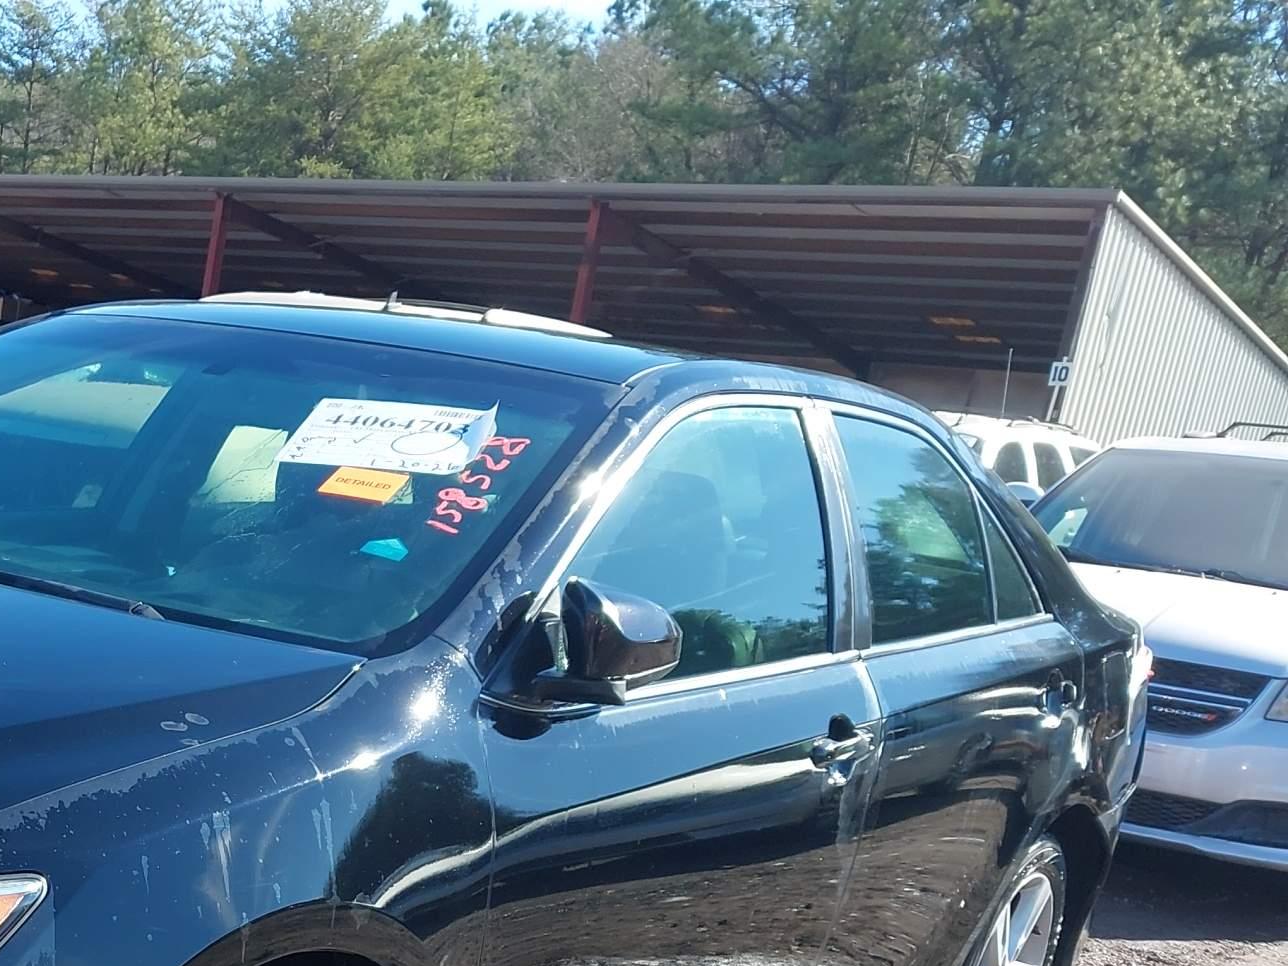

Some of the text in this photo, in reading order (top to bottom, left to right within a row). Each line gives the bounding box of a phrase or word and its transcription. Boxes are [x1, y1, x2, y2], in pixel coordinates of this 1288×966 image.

[1052, 366, 1070, 382] 10
[325, 413, 471, 435] 44064703
[335, 476, 392, 490] DETAILED
